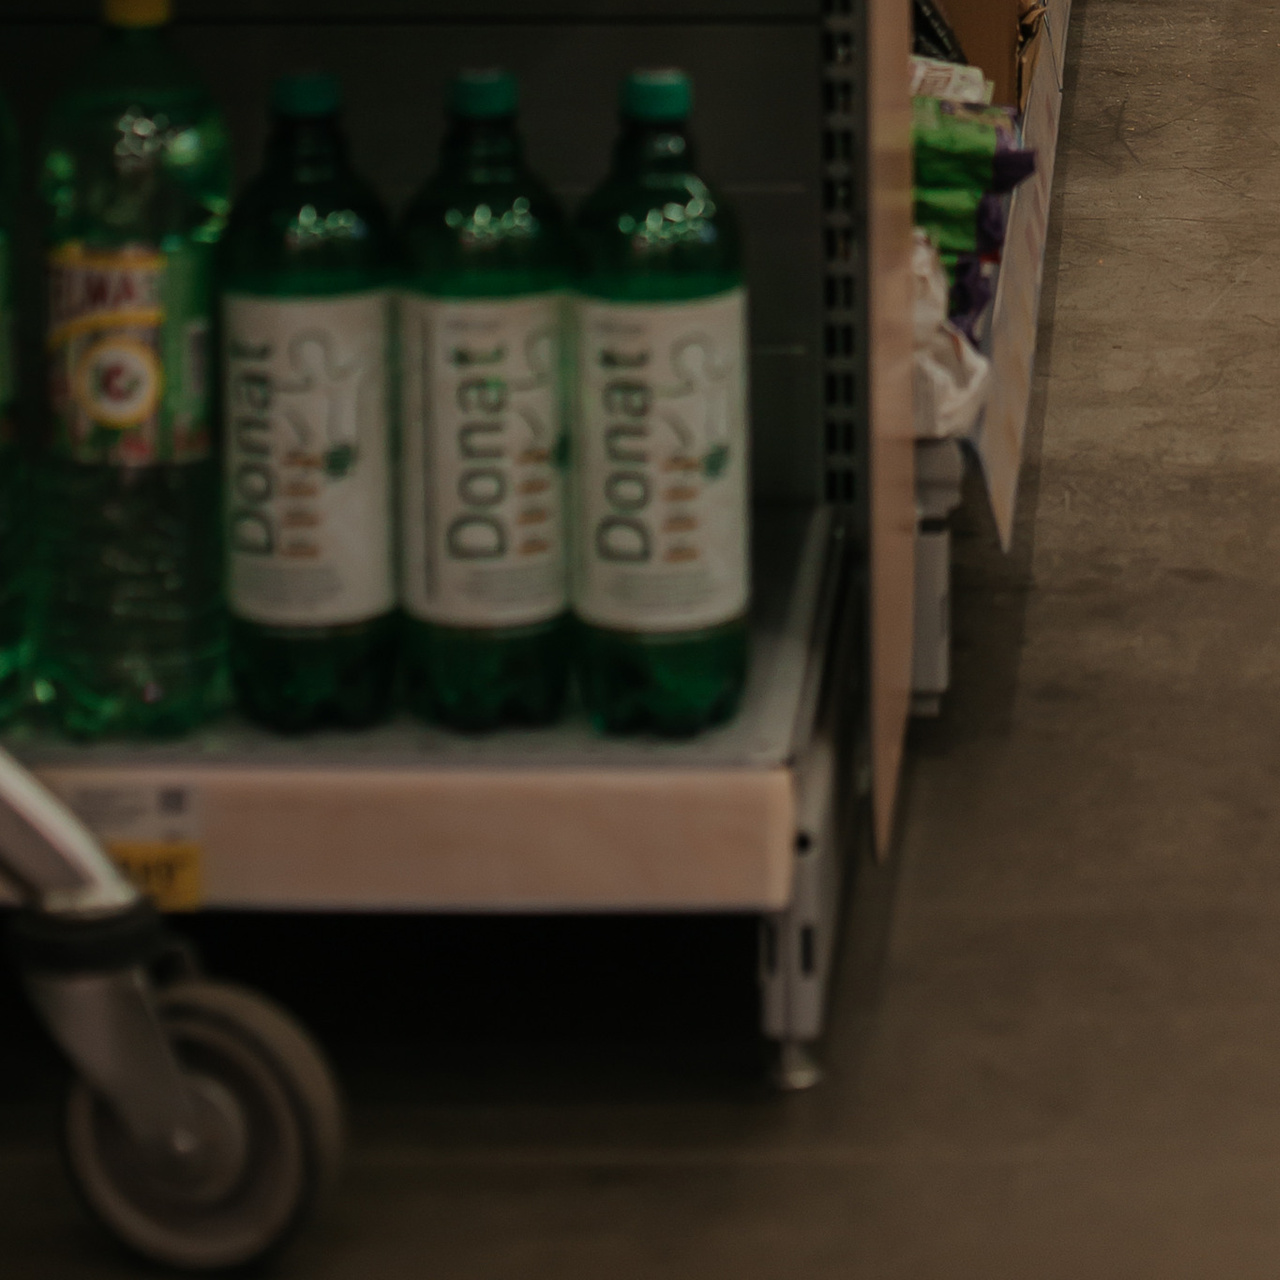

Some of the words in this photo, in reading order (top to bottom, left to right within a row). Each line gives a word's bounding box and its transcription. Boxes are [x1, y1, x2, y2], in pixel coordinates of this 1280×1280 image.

[230, 342, 274, 557] Donat
[446, 344, 509, 561] Donat
[596, 345, 652, 563] Donat
